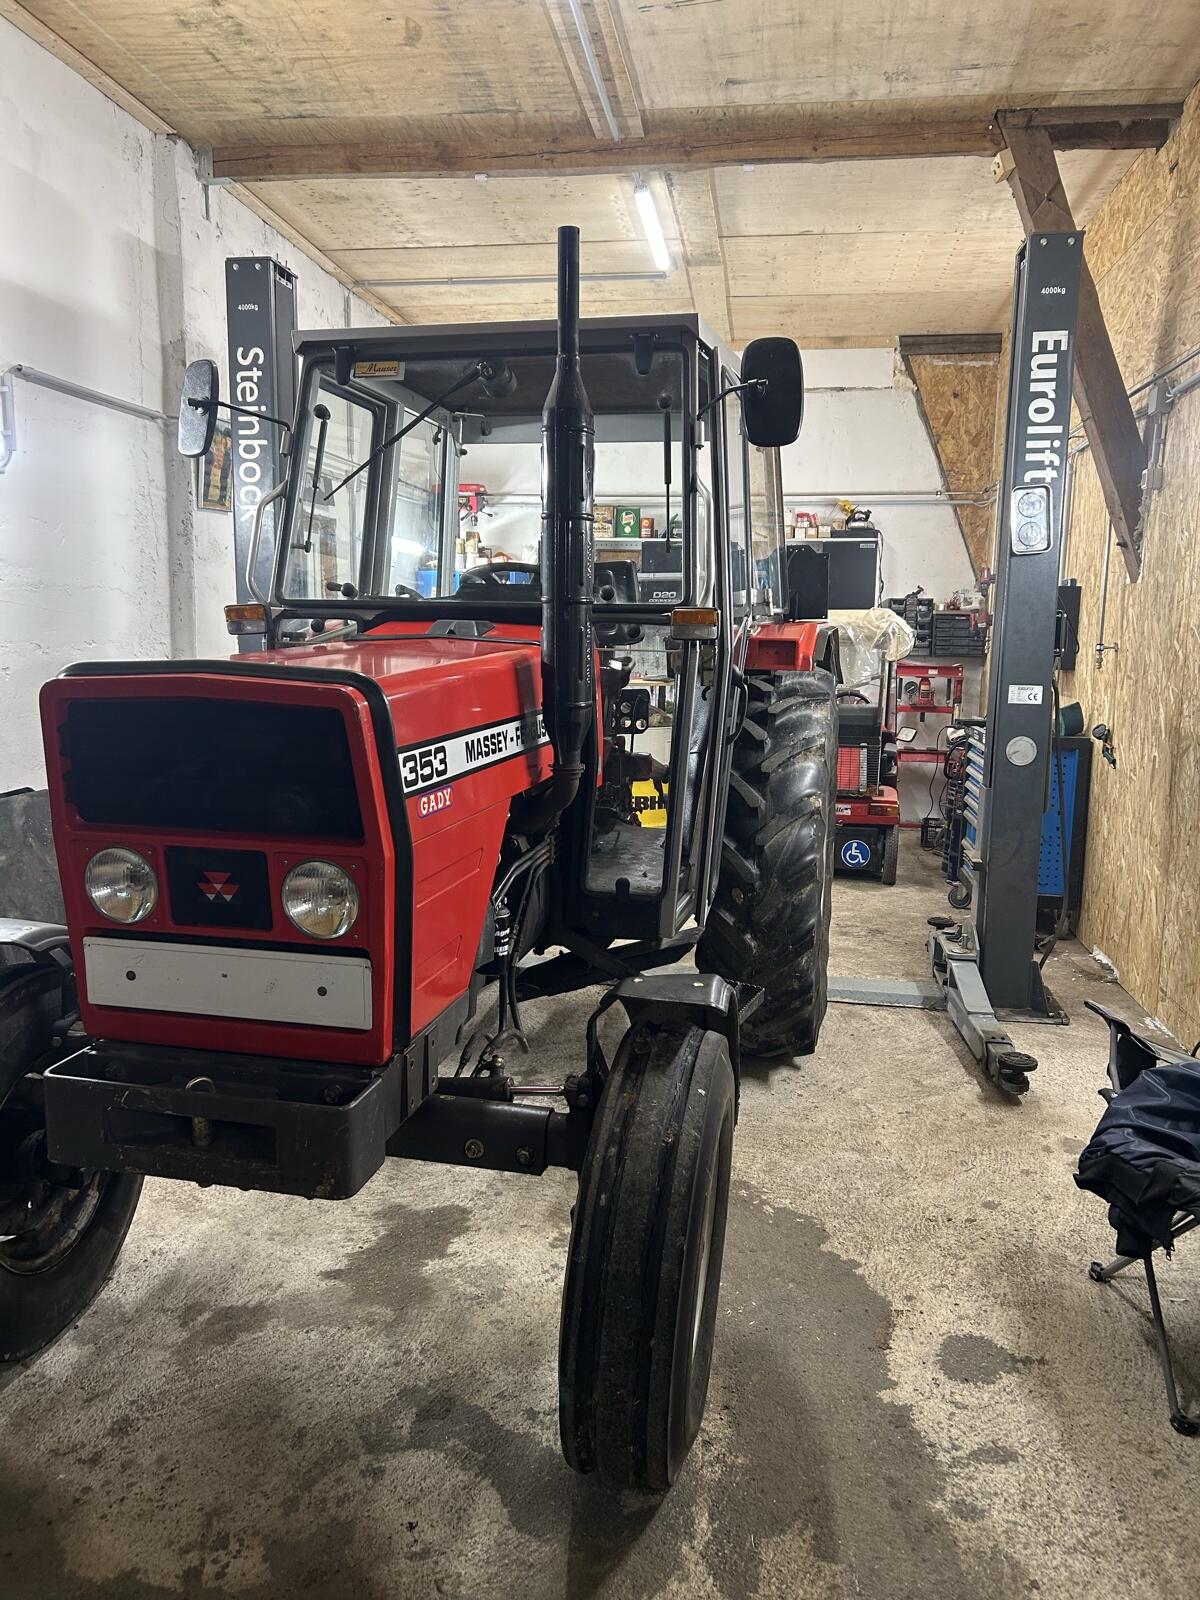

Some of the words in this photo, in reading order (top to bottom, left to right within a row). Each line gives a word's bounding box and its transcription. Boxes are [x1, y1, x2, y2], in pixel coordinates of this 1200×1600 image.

[1041, 286, 1066, 295] 4000kg
[1023, 330, 1069, 483] Eurolift
[236, 347, 269, 522] Steinbock
[402, 745, 448, 788] 353
[420, 788, 451, 814] GADY
